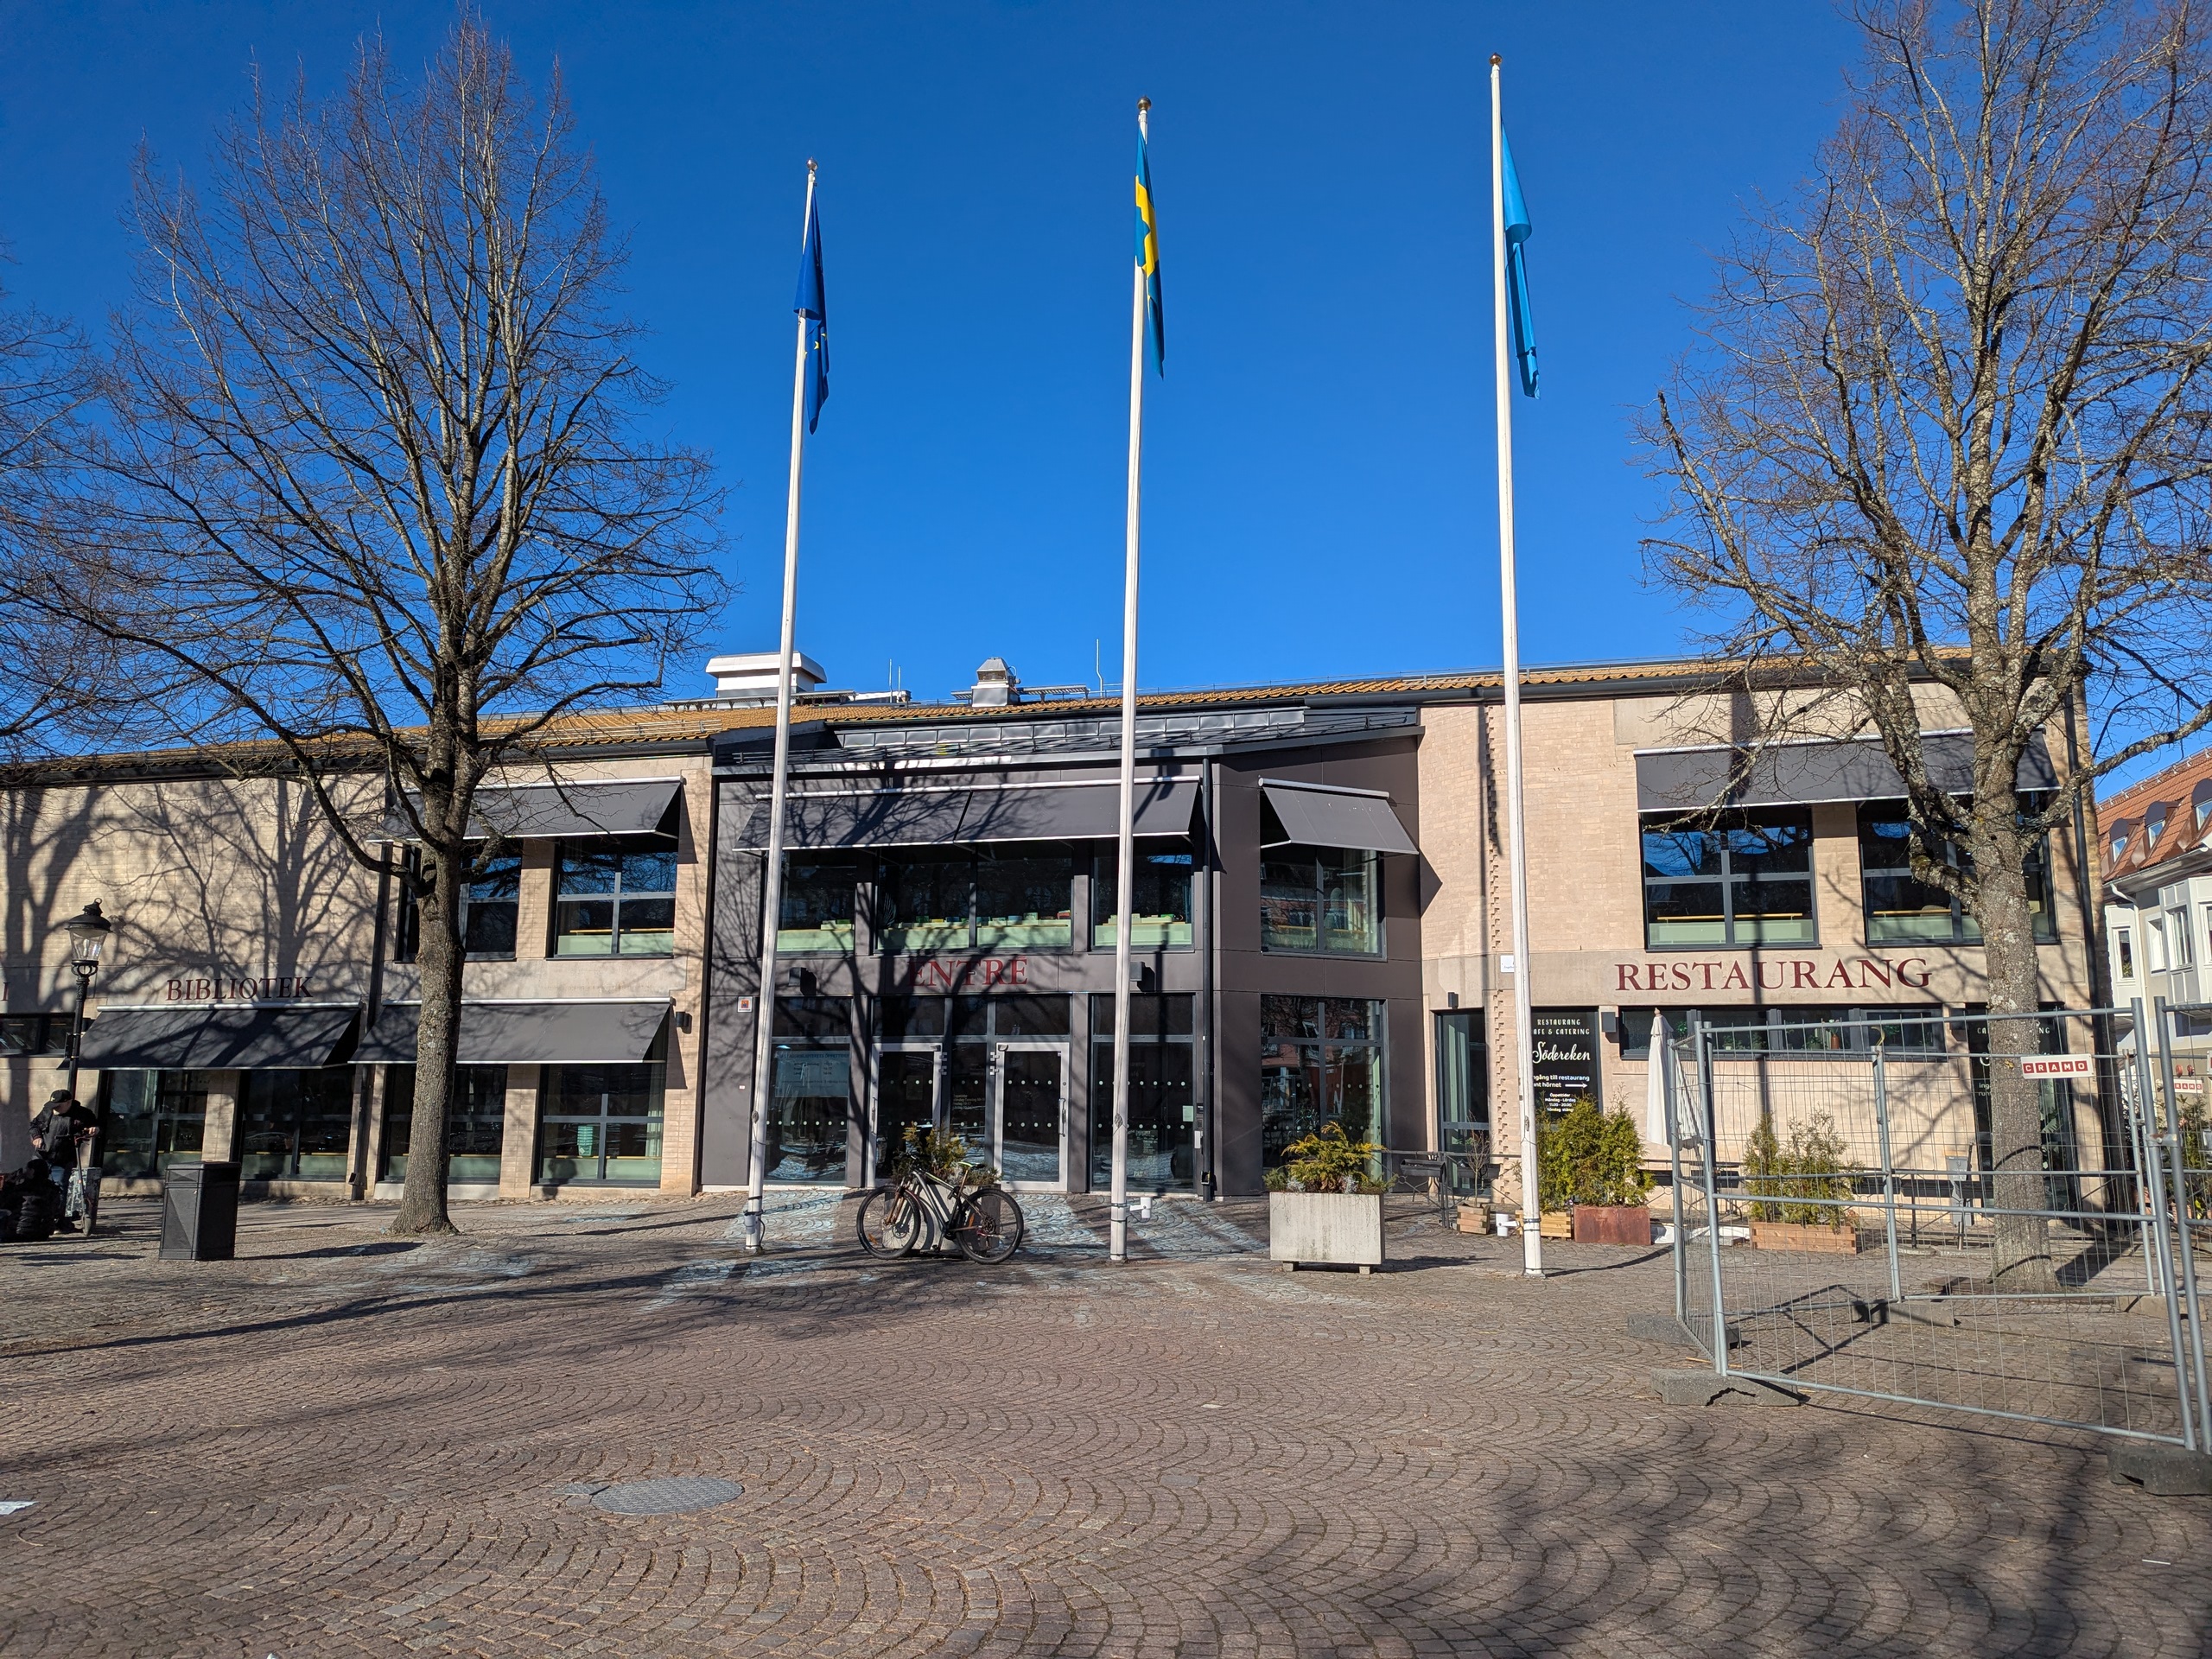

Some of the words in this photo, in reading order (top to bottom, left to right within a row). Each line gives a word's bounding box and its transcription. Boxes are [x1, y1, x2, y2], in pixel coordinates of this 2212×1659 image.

[909, 955, 1027, 987] ENTRÉ
[1615, 958, 1933, 991] RESTAURANG
[166, 976, 314, 1001] BIBLIOTEK
[1532, 1041, 1591, 1064] Södereken
[2024, 1062, 2086, 1072] CRAMO
